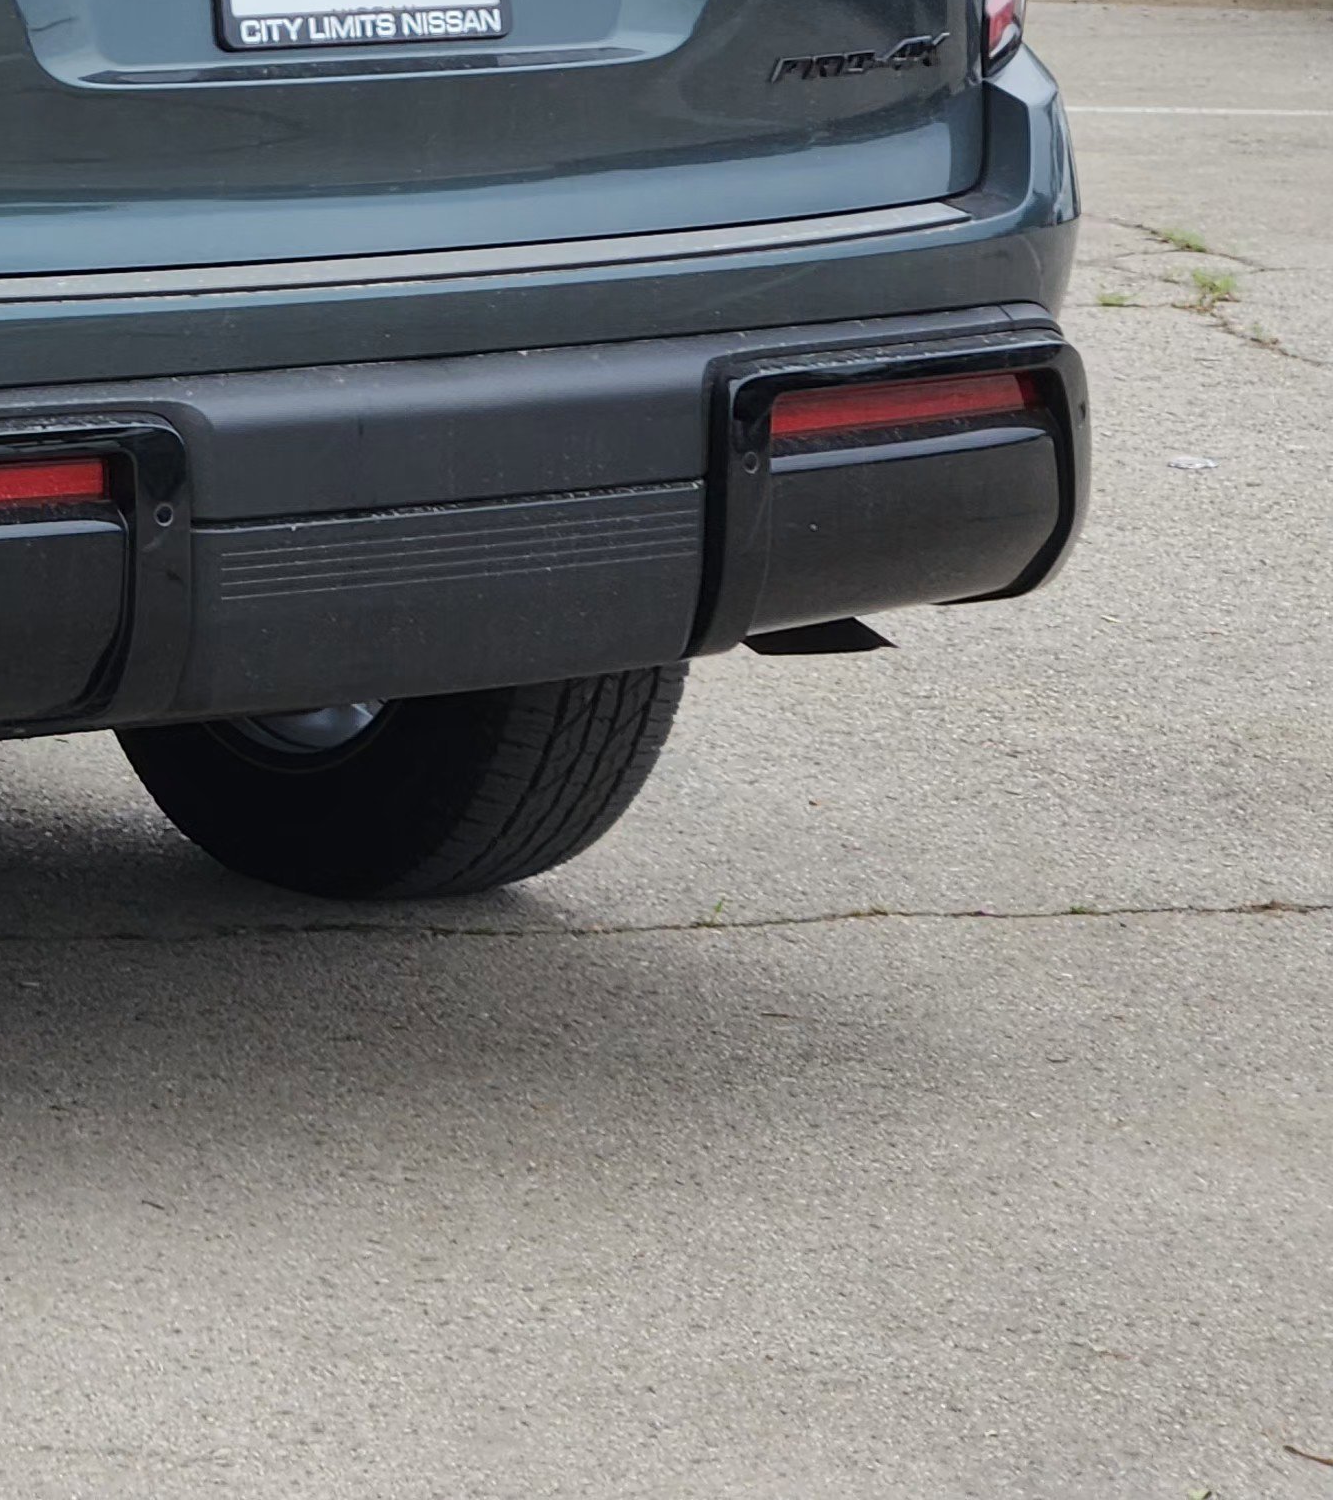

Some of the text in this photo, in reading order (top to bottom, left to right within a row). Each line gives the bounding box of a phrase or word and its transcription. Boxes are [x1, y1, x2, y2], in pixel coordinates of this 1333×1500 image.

[240, 8, 502, 45] CITY LIMITS NISSAN
